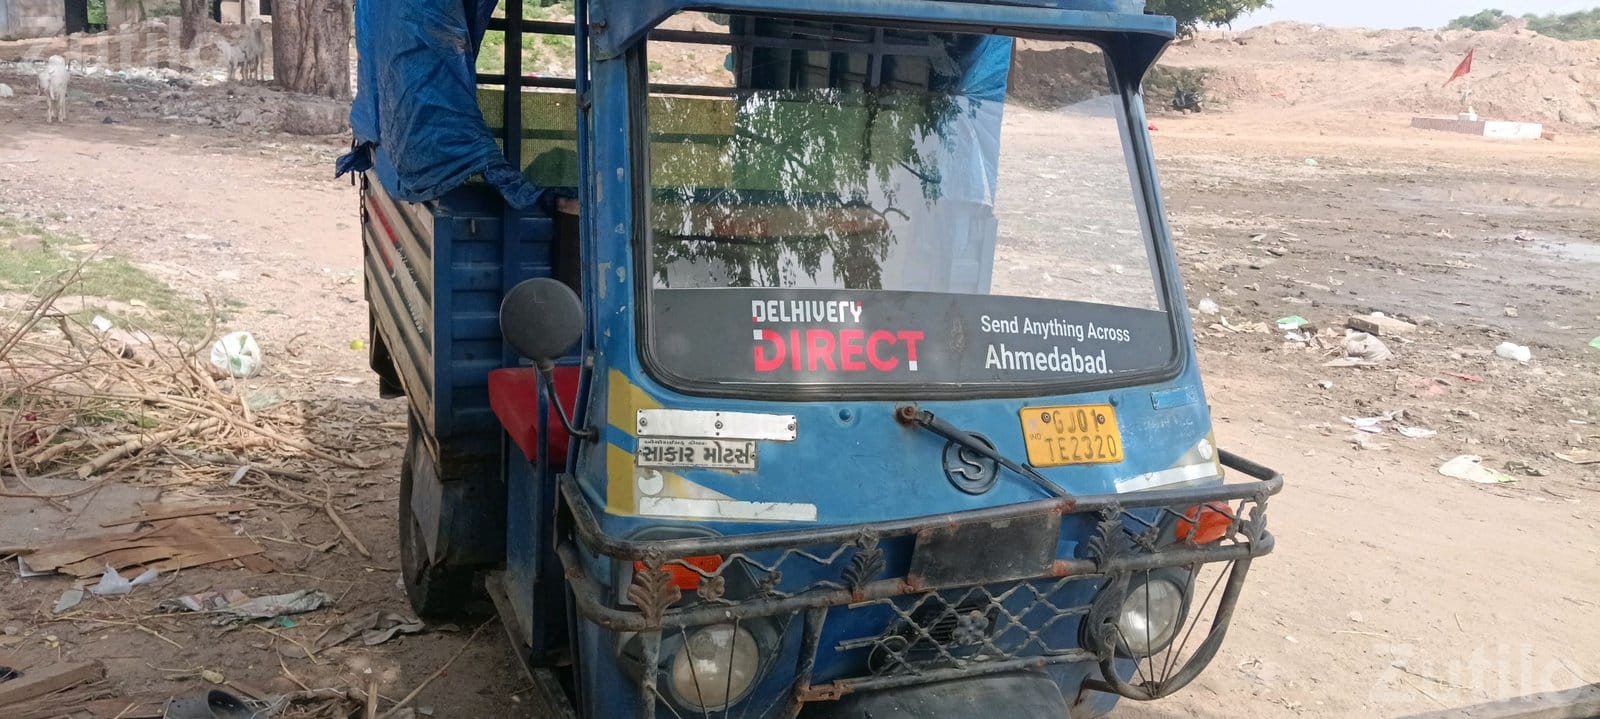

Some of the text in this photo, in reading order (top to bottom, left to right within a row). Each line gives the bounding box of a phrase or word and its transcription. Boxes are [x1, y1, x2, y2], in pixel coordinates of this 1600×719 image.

[751, 300, 863, 323] DELHIVERY
[980, 315, 1131, 342] Send Anything Across
[753, 329, 925, 372] DIRECT
[985, 343, 1114, 374] Ahmedabad.
[641, 441, 752, 464] સાકાર મોટર્સ
[1044, 434, 1117, 462] TE2320
